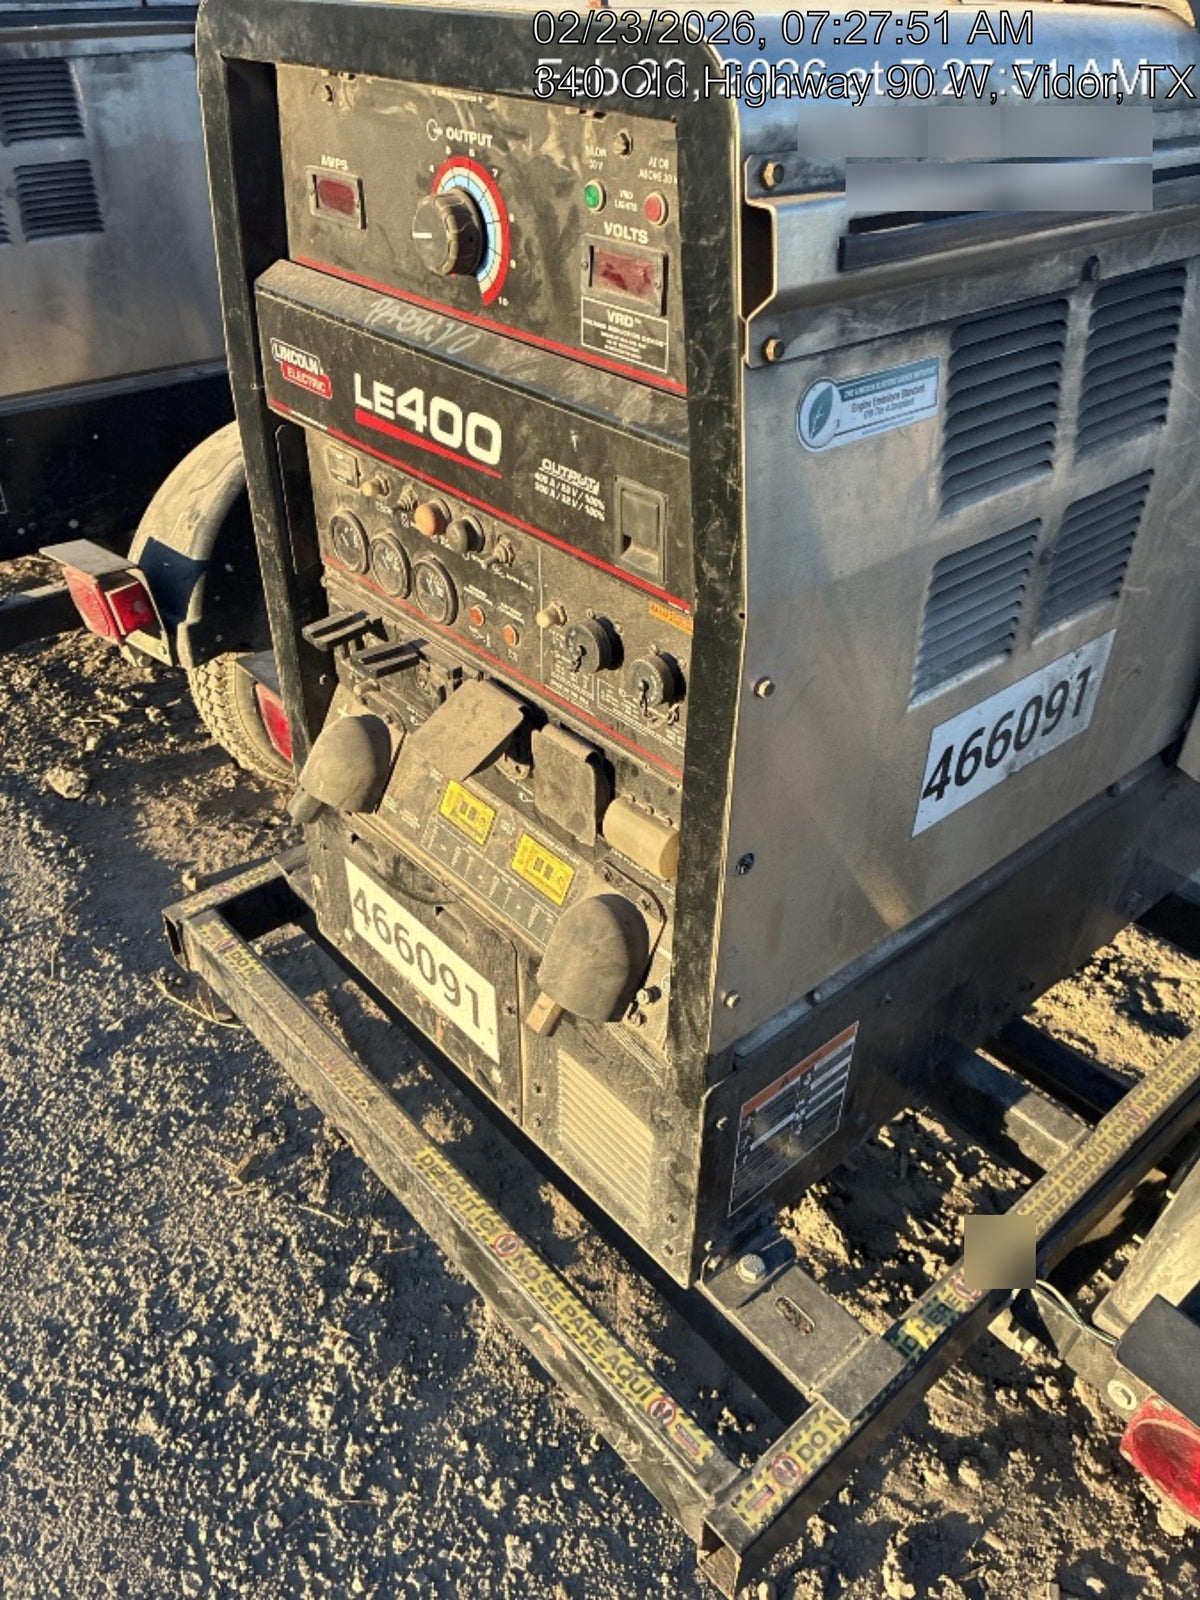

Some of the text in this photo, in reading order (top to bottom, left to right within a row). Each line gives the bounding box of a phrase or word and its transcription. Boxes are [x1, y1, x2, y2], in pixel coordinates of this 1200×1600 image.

[446, 126, 493, 148] OUTPUT
[321, 153, 349, 171] AMPS
[603, 221, 649, 245] VOLTS
[274, 343, 318, 376] LINCOLN
[287, 367, 327, 394] ELECTRIC
[354, 372, 502, 465] LE400
[921, 665, 1092, 802] 466091
[353, 887, 480, 1030] 466091
[1142, 1089, 1160, 1109] NO
[1156, 1074, 1173, 1093] SE
[1061, 1137, 1113, 1189] DEBOUT
[513, 1254, 541, 1280] NO
[538, 1279, 565, 1307] SE
[560, 1304, 608, 1355] PARE
[796, 1430, 828, 1462] DO
